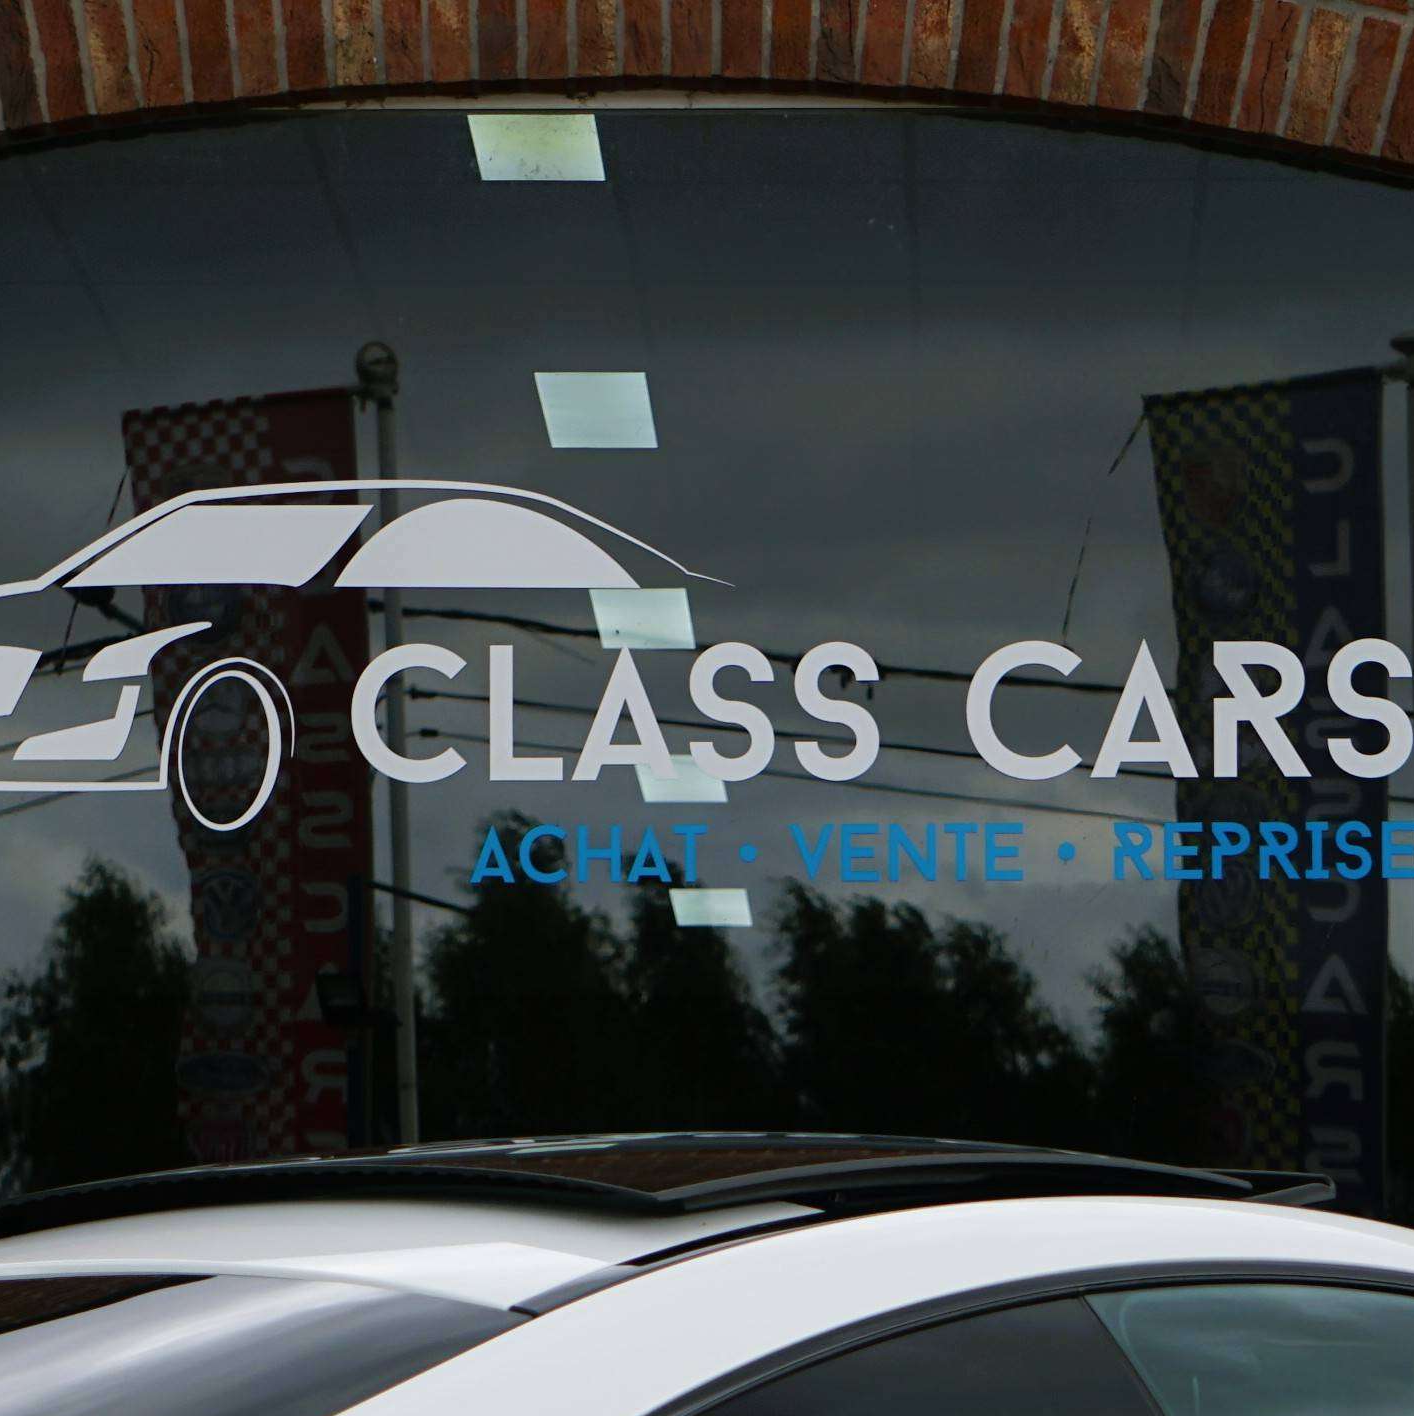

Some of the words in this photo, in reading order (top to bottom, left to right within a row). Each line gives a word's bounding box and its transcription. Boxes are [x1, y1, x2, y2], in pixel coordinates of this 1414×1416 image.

[350, 643, 881, 783] CLASS
[469, 823, 709, 885] ACHAT
[788, 822, 1024, 883] VENTE
